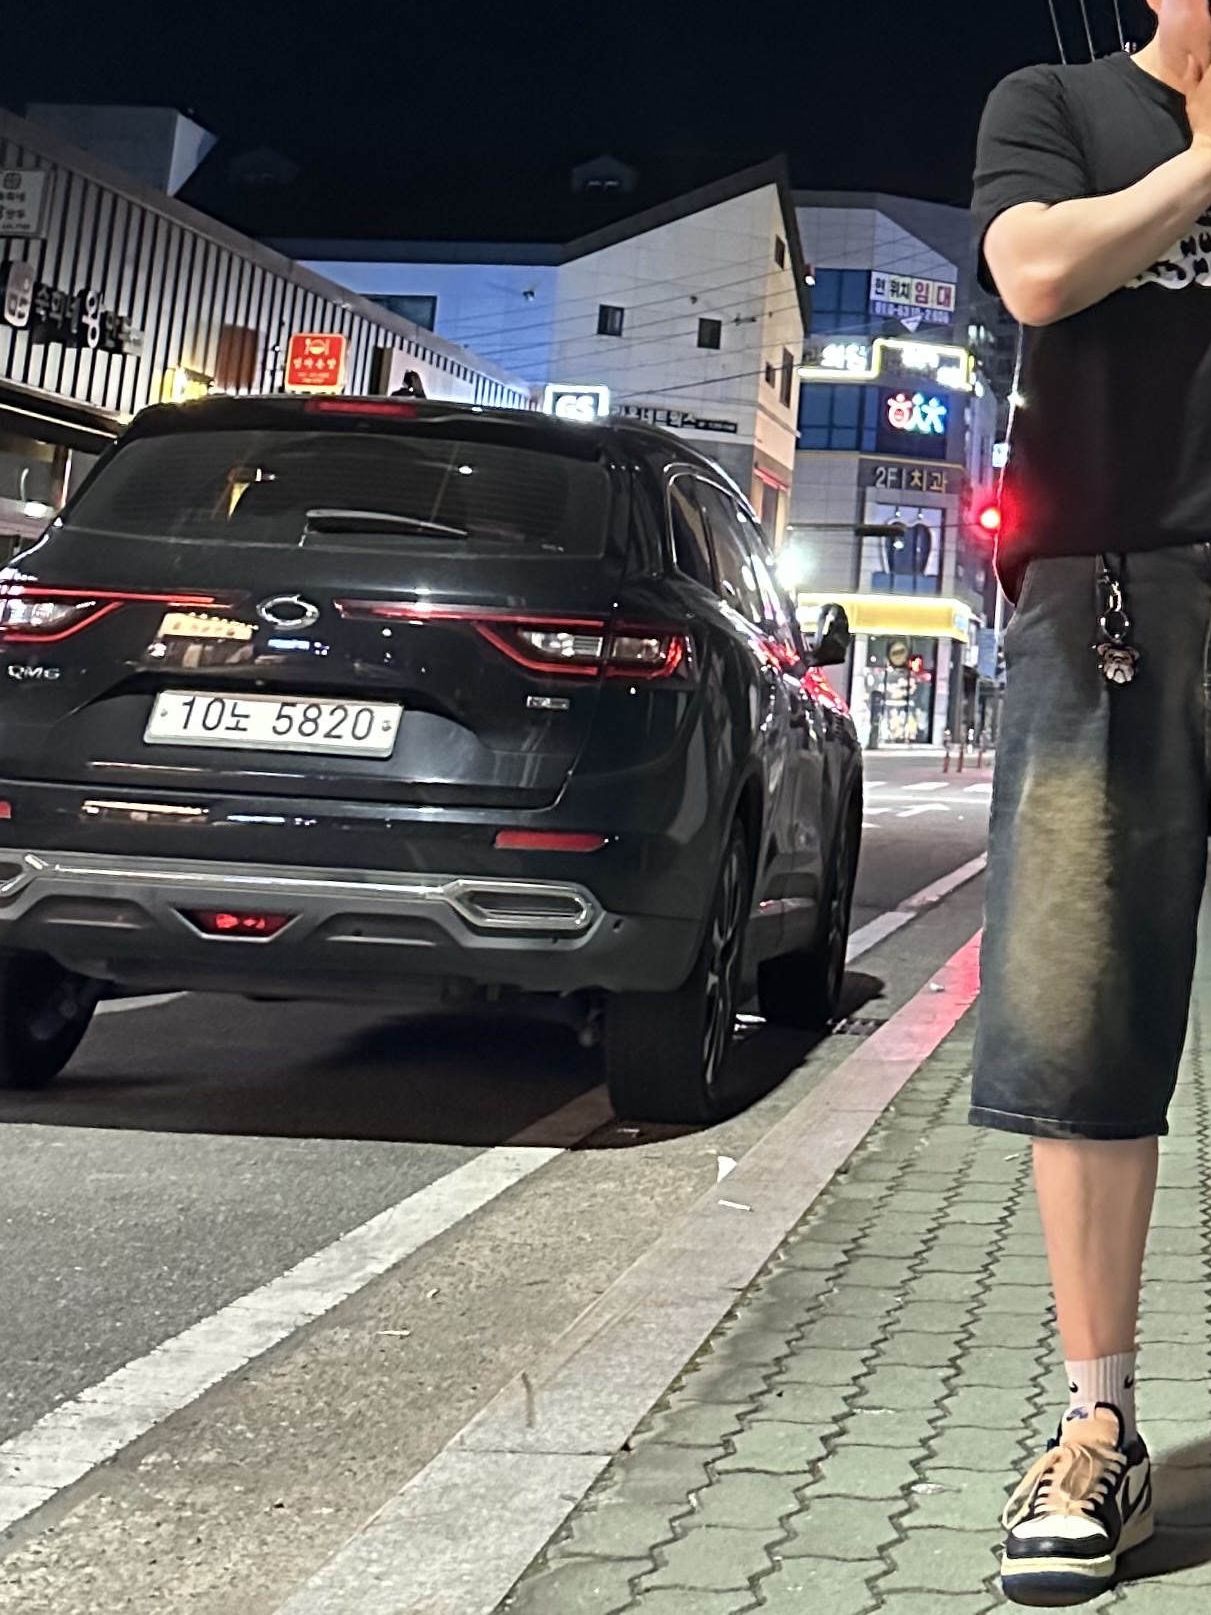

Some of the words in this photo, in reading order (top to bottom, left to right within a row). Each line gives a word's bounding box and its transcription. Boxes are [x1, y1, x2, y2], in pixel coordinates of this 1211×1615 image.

[875, 466, 899, 487] 2F
[911, 469, 948, 494] 치과
[180, 696, 252, 733] 10노
[271, 701, 376, 742] 5820
